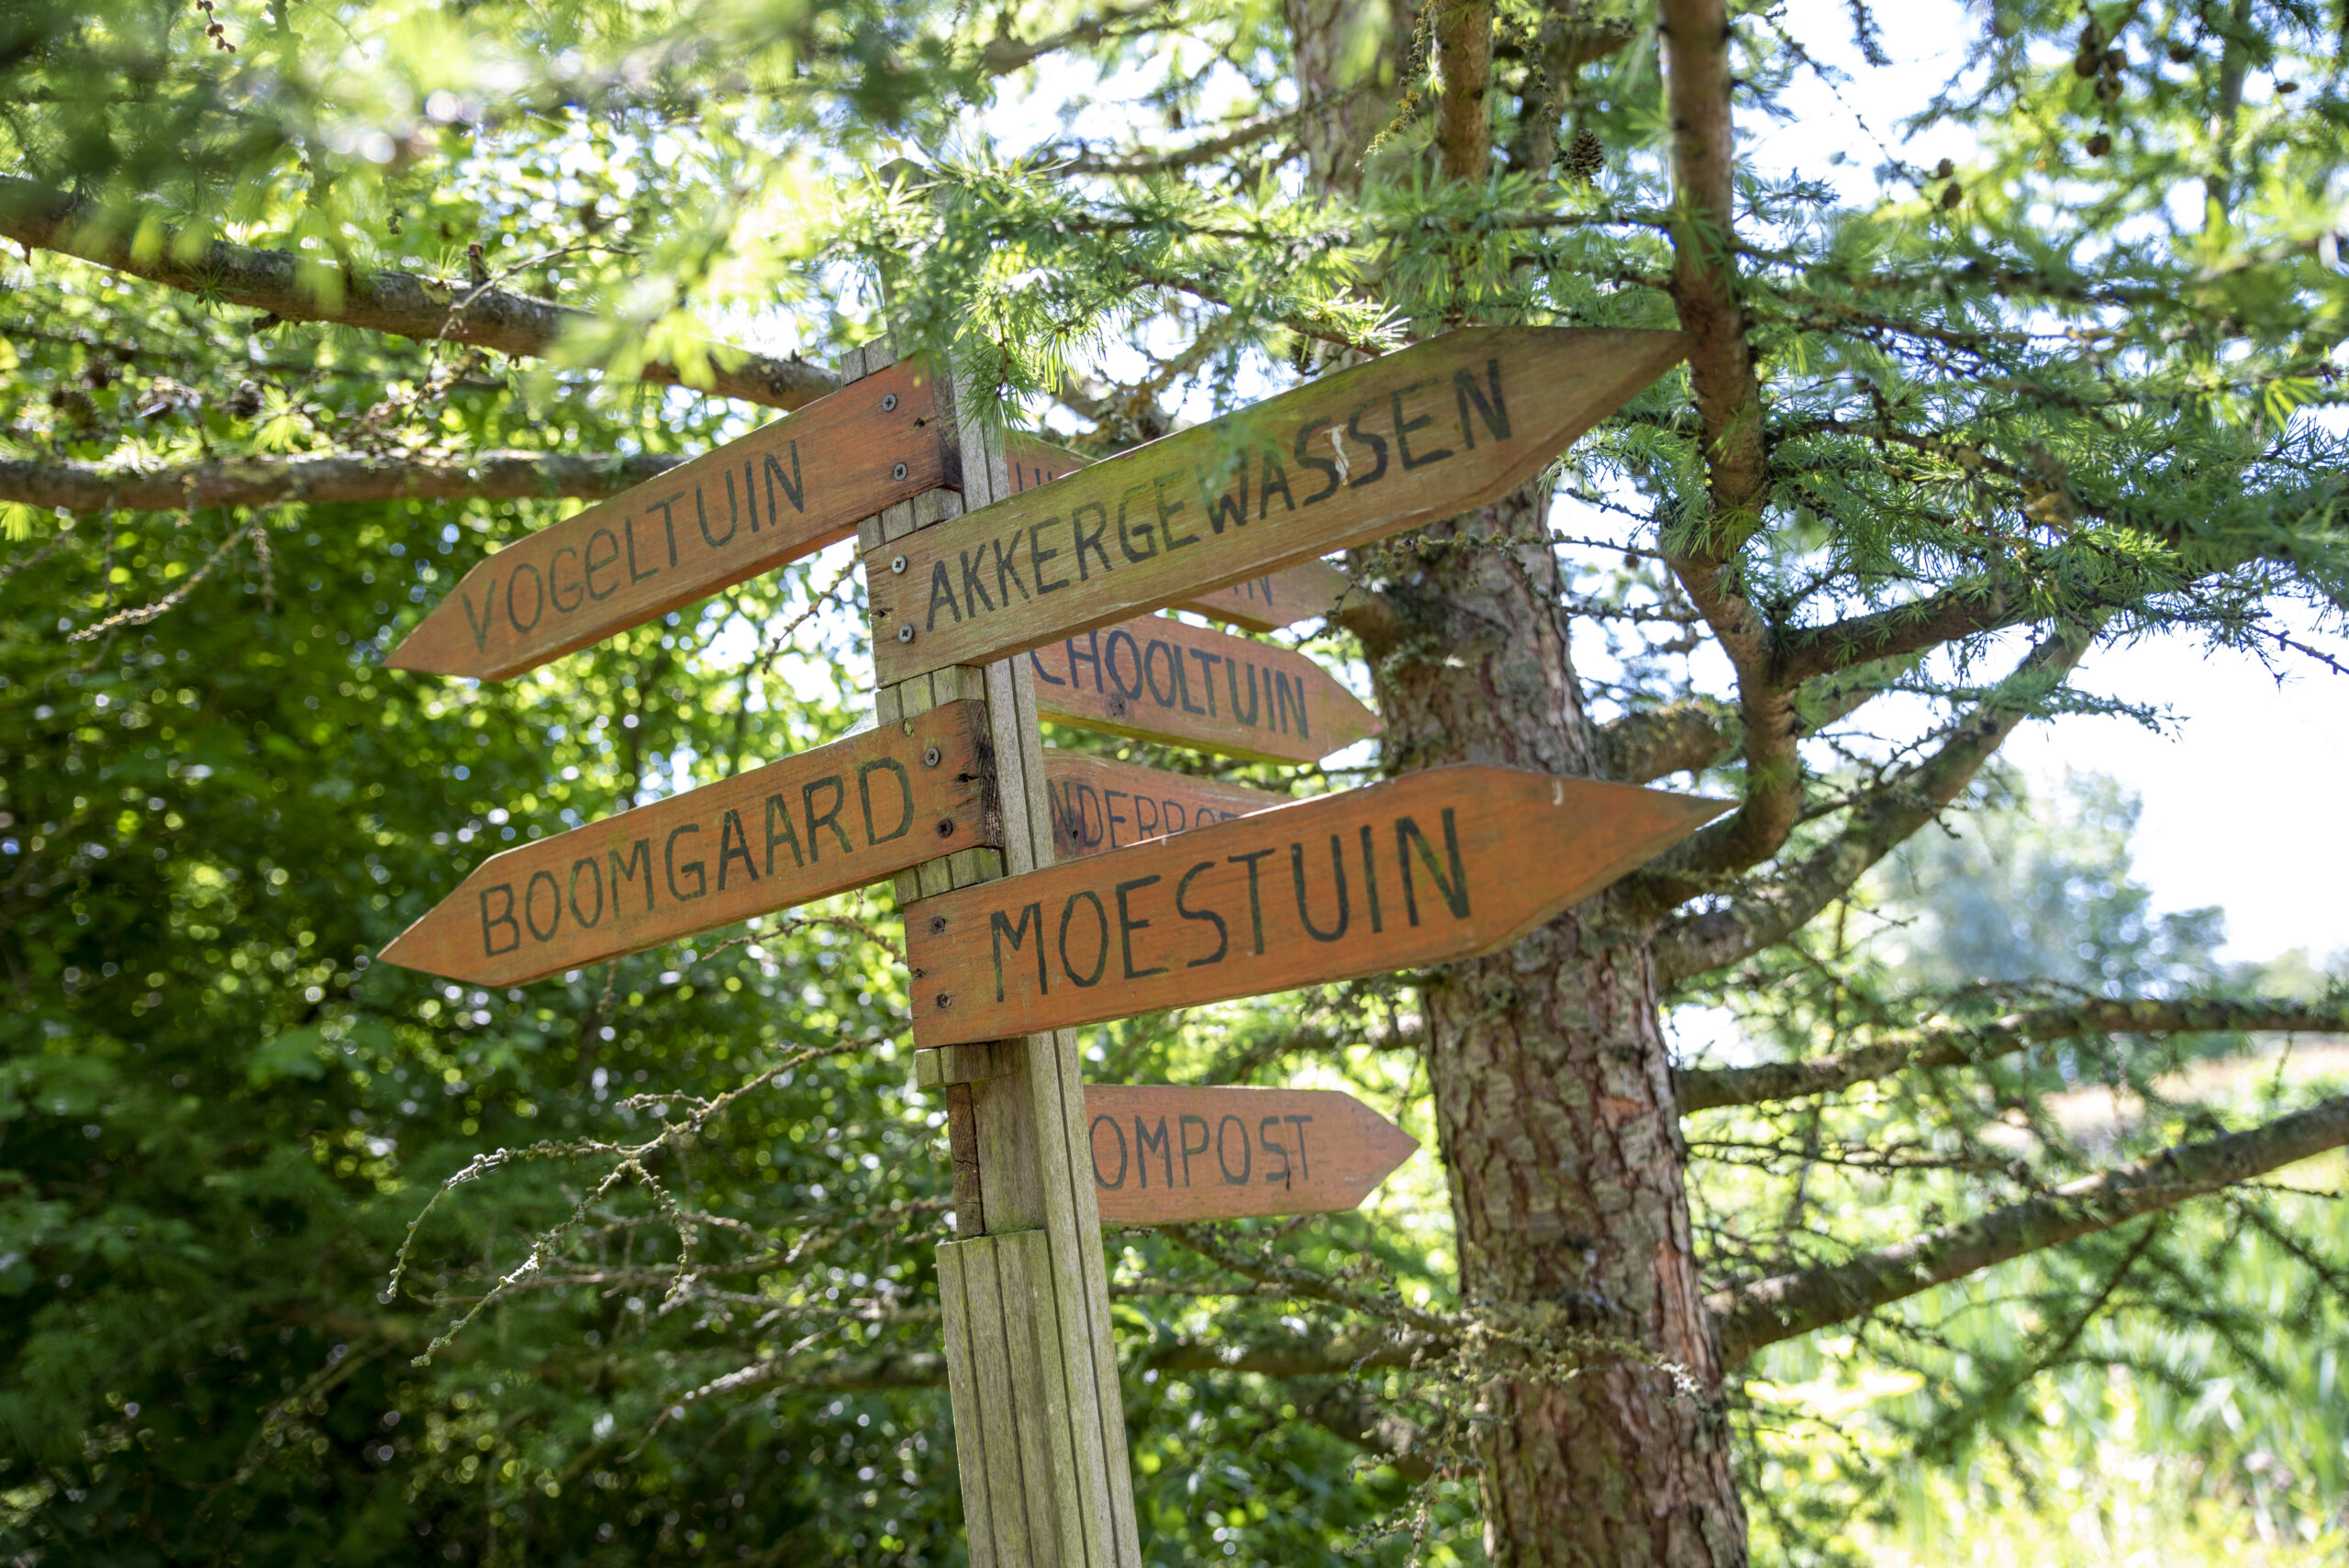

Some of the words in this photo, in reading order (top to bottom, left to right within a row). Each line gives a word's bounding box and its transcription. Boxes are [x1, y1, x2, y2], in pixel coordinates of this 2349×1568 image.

[926, 358, 1514, 633] AKKERGEWASSEN
[480, 757, 915, 958] BOOMGAARD
[990, 807, 1469, 1004] MOESTUIN
[1088, 1113, 1314, 1190] OMPOST
